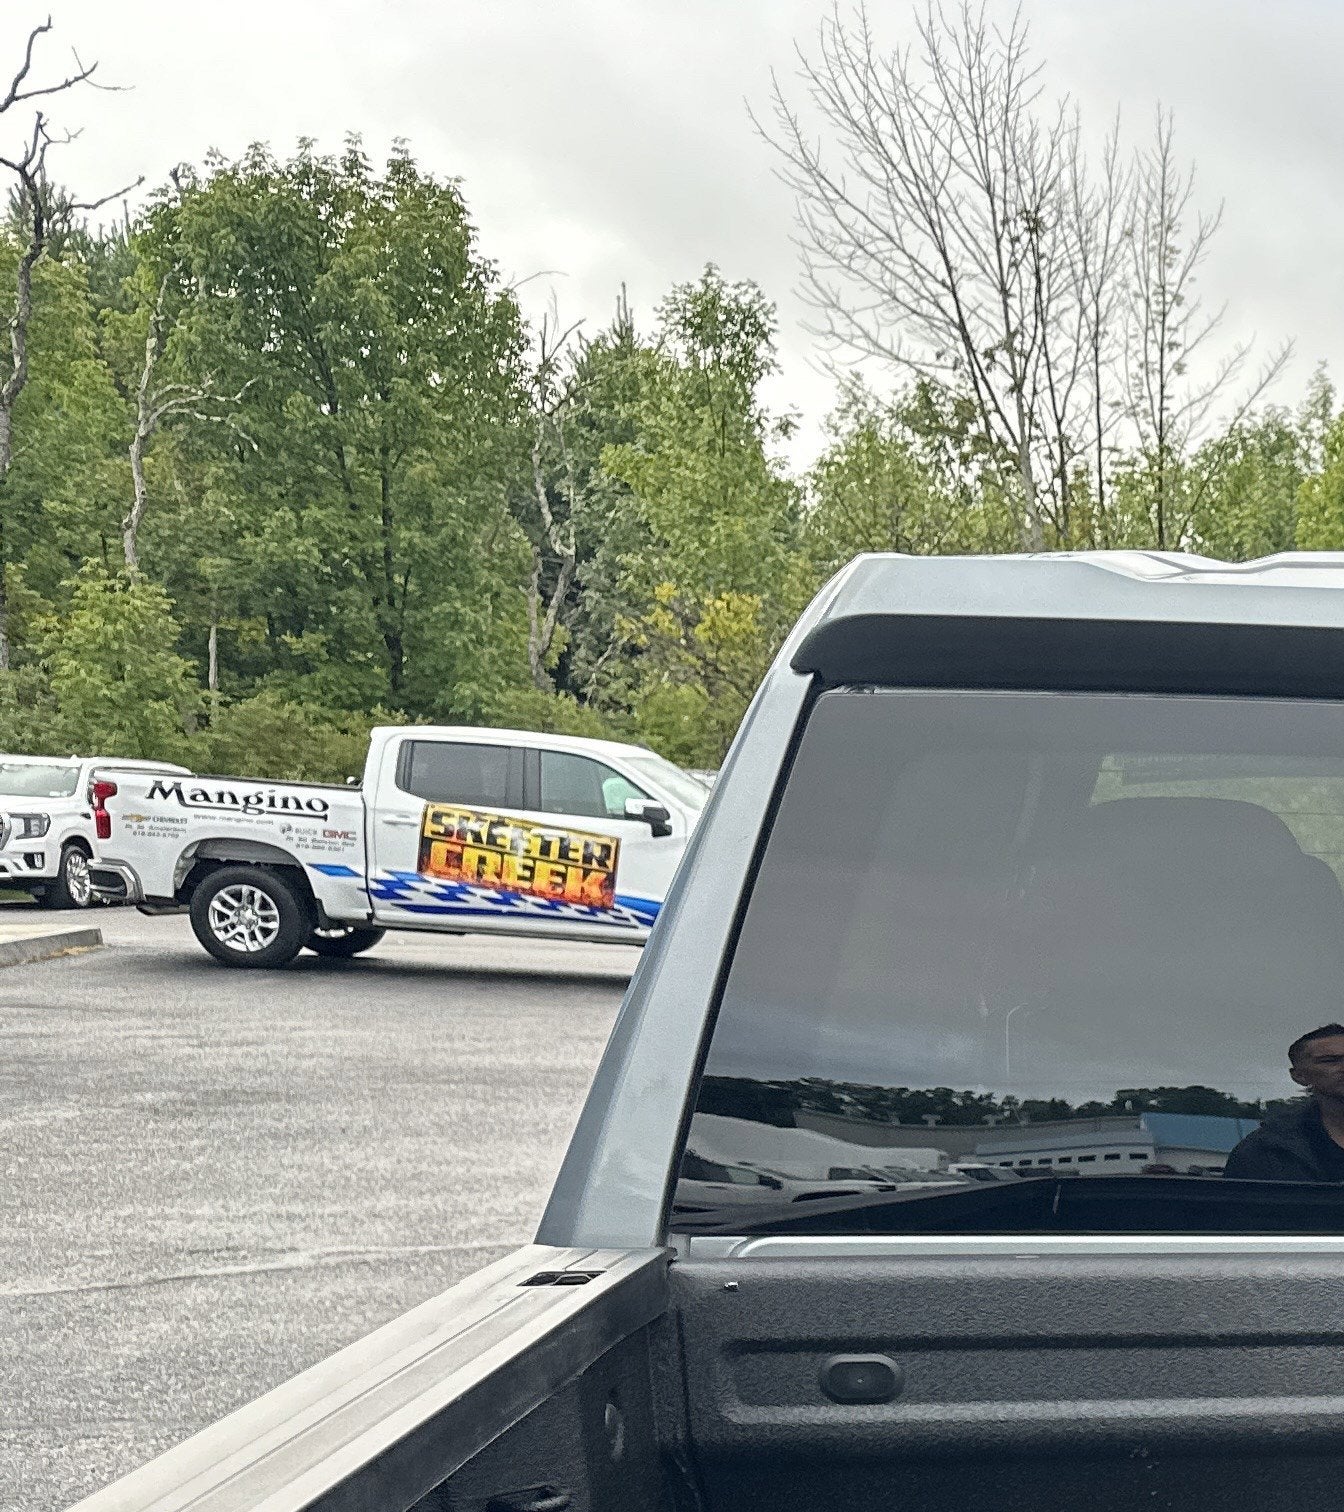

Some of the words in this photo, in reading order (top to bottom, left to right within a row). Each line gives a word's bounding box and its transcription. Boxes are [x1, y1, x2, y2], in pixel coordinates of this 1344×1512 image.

[146, 780, 329, 822] Mangino
[322, 828, 357, 842] GMC
[430, 809, 613, 868] SKEETER
[429, 841, 608, 902] CREEK
